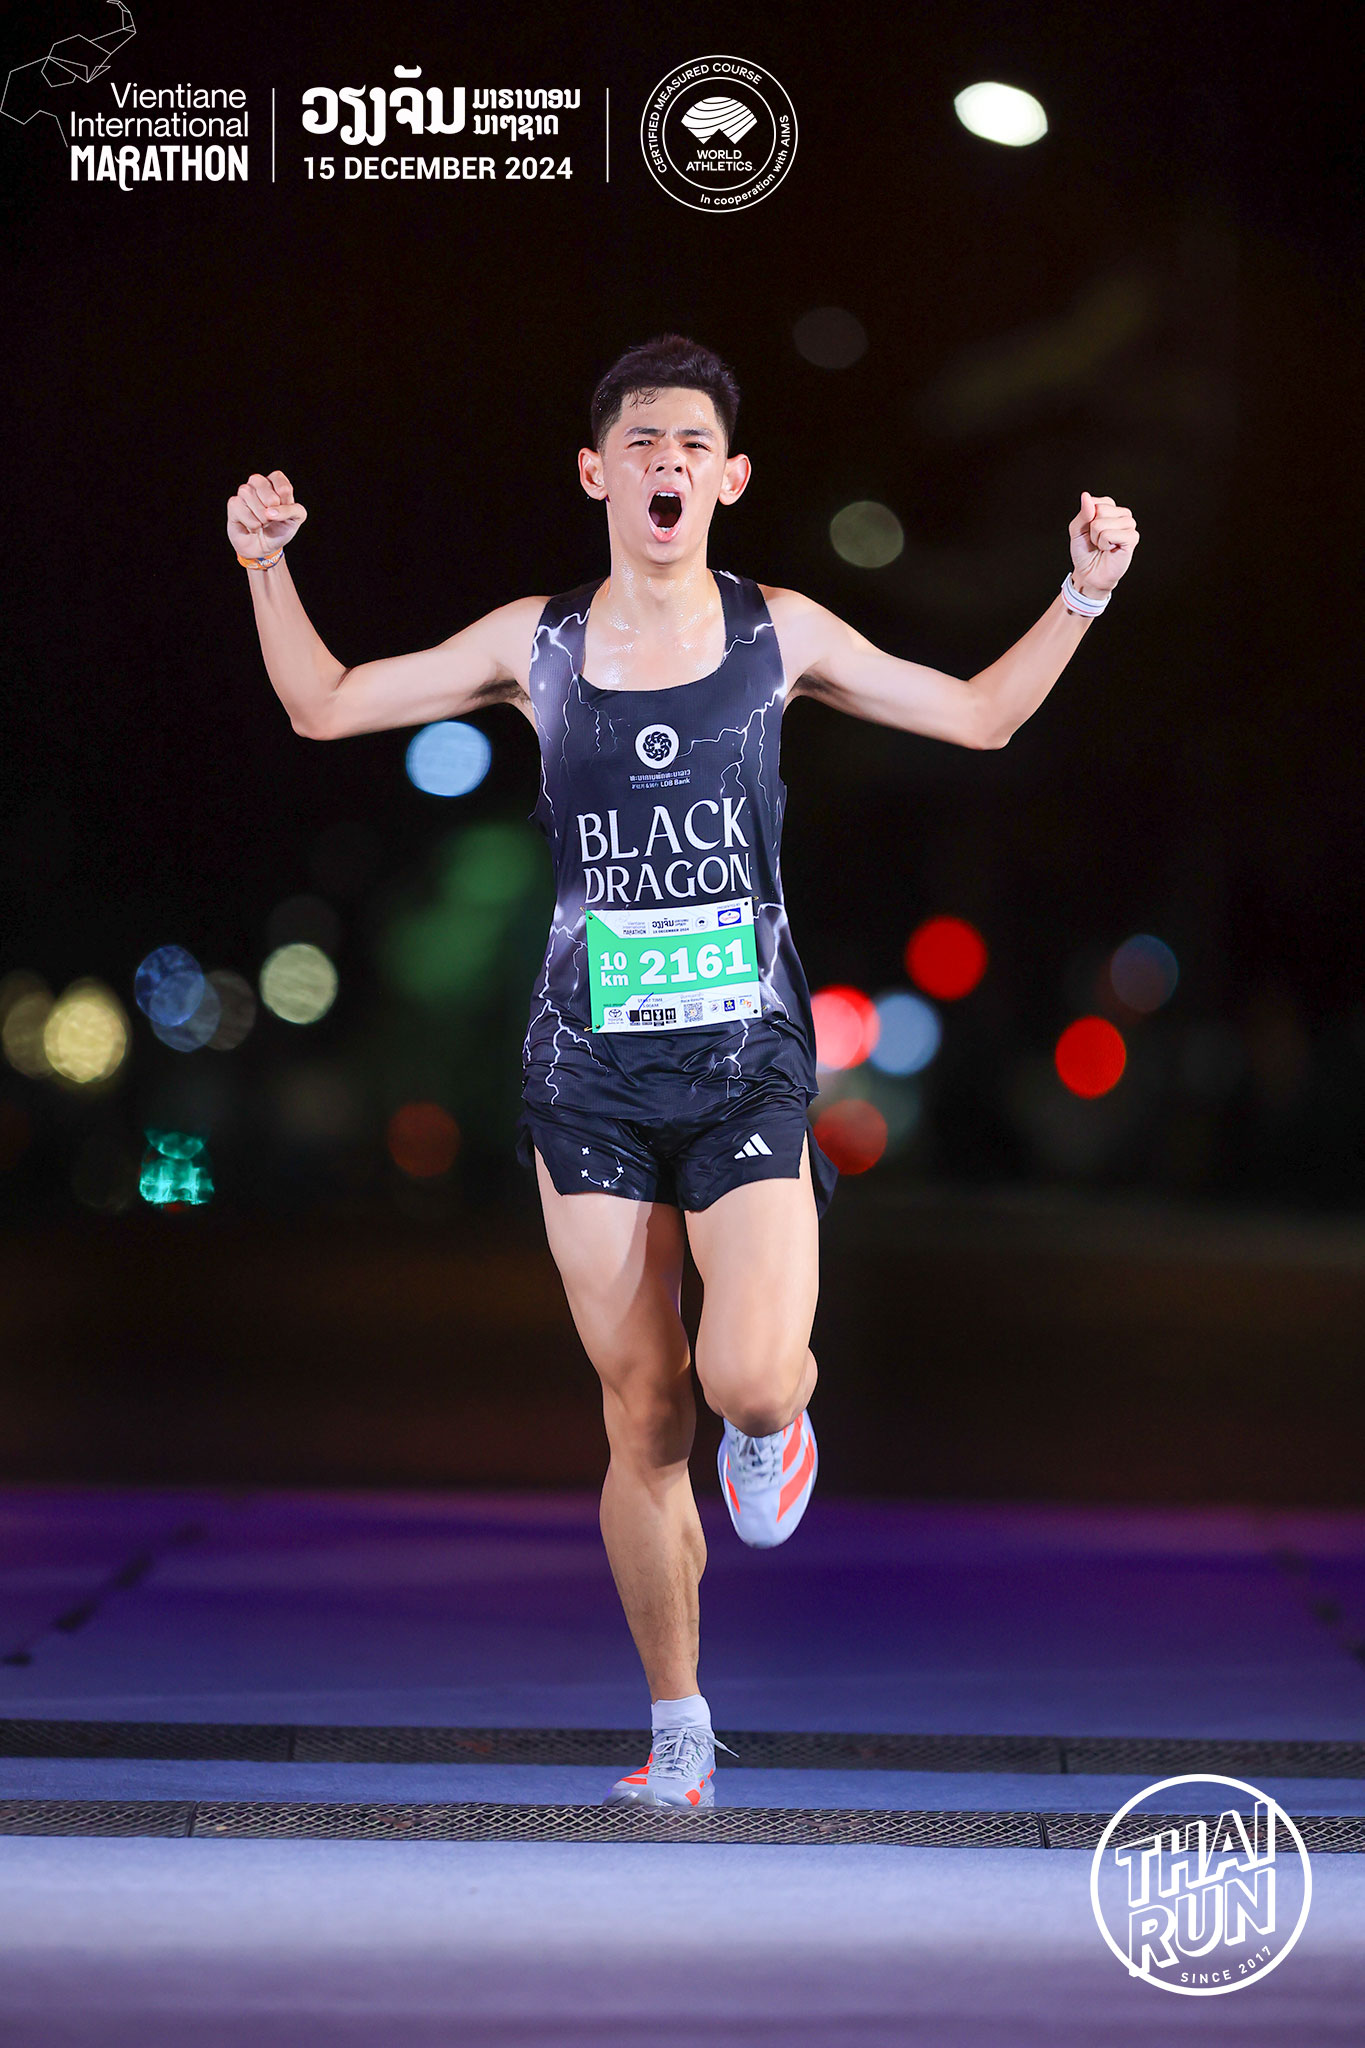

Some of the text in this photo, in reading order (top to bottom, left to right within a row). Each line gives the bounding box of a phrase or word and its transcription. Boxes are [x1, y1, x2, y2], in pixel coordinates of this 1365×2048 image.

[674, 778, 690, 786] Bank
[577, 797, 749, 862] BLACK
[584, 853, 752, 903] DRAGON
[600, 952, 627, 971] 10
[639, 939, 752, 985] 2161
[600, 971, 629, 986] km
